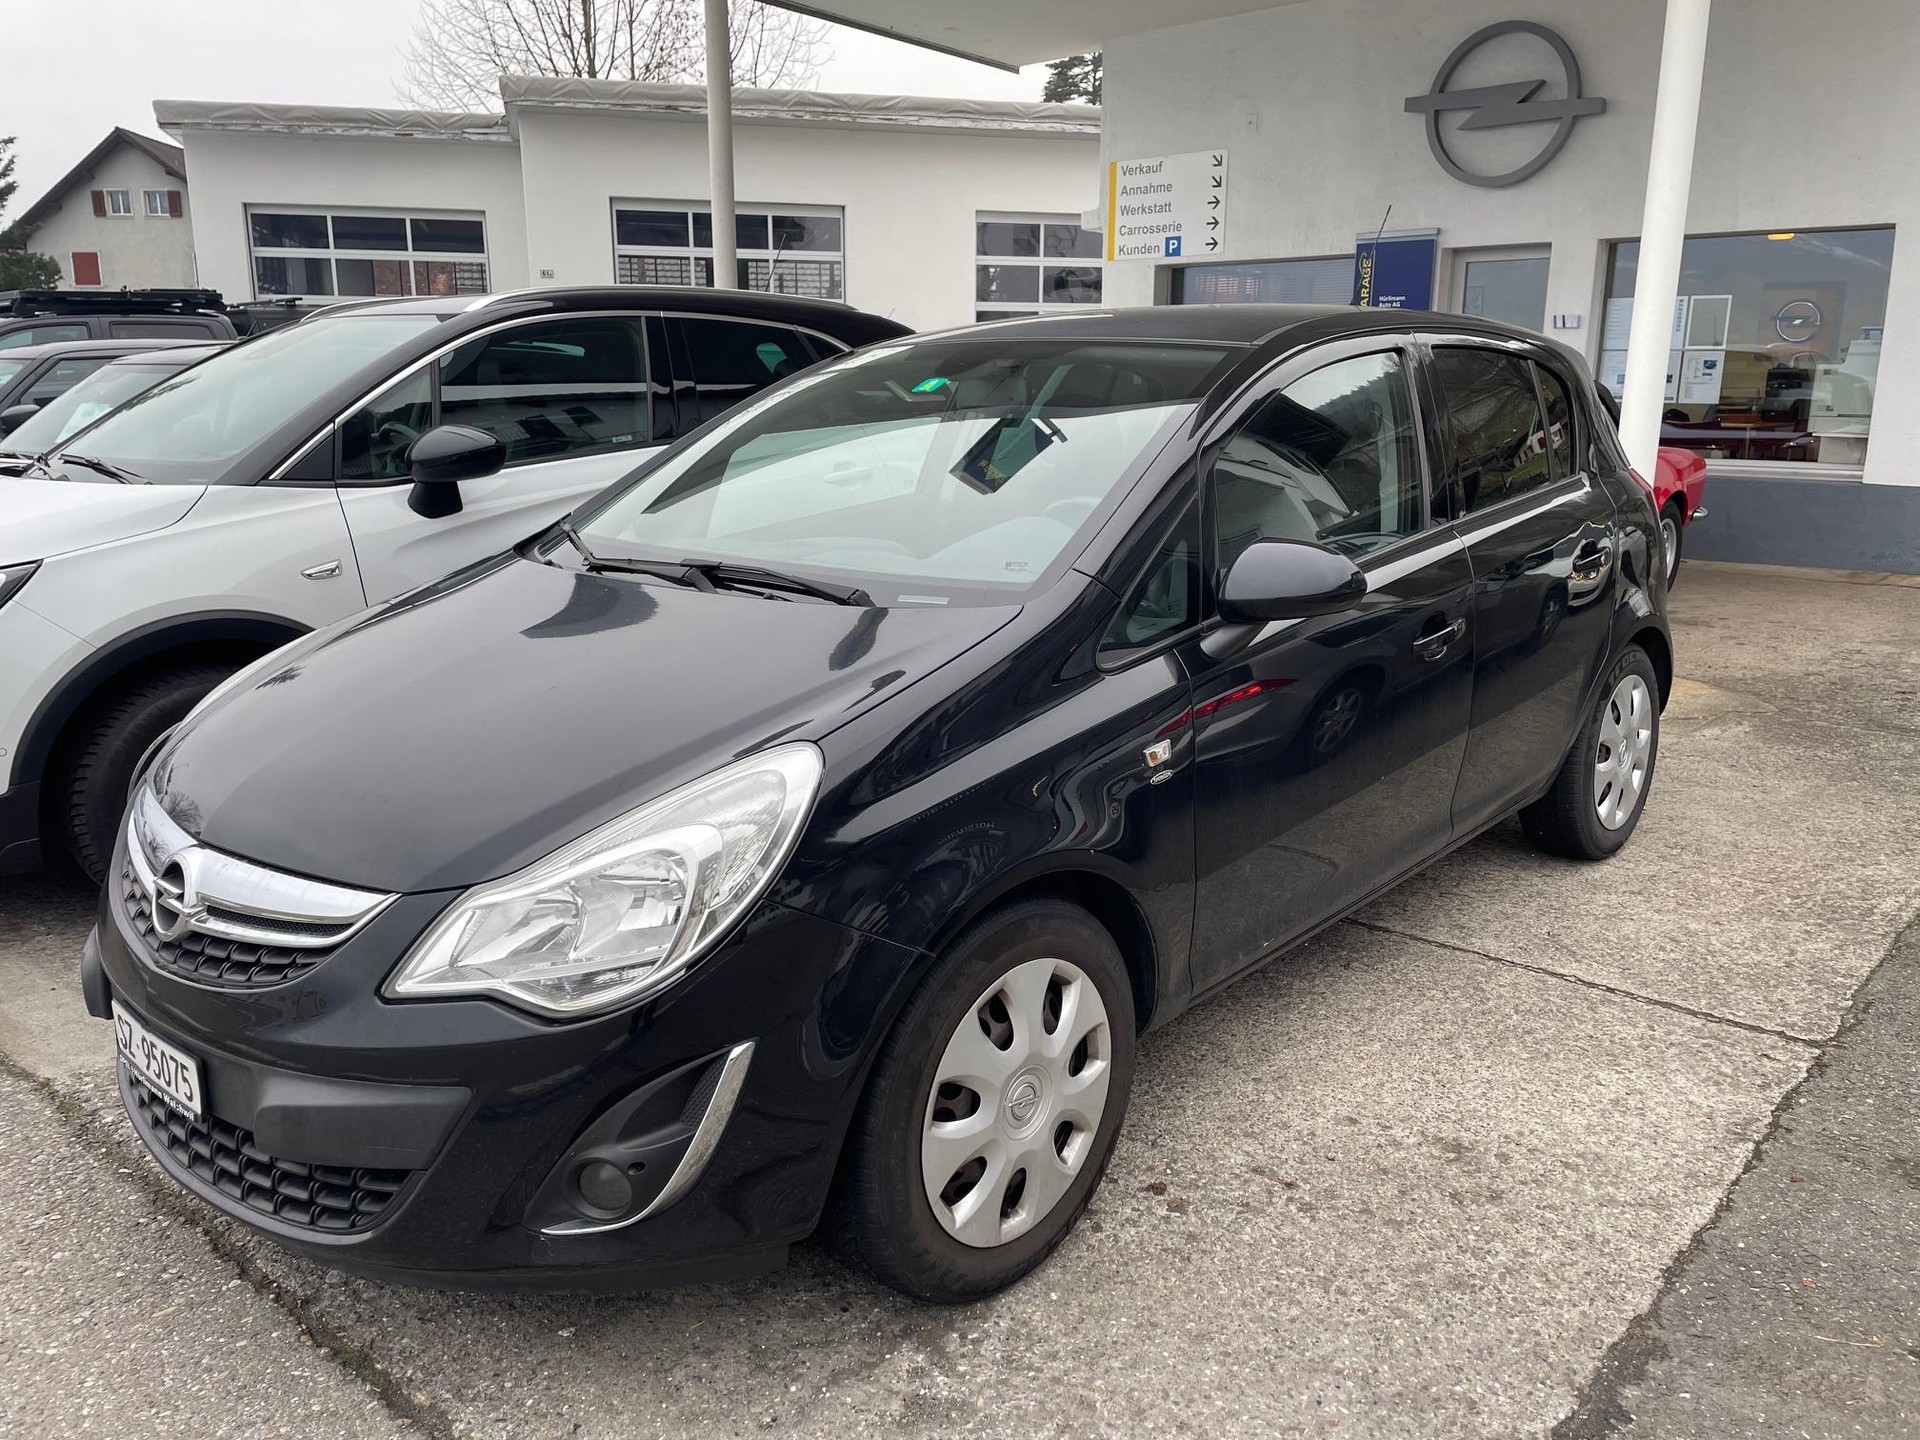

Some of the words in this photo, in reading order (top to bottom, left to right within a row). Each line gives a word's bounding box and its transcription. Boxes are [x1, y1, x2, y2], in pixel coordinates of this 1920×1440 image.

[1121, 161, 1163, 177] Verkauf
[1120, 183, 1172, 197] Annahme
[1120, 202, 1172, 217] Werkstatt
[1119, 221, 1183, 236] Carrosserie
[1118, 243, 1160, 256] Kunden
[1360, 258, 1372, 308] ARAGE
[117, 1014, 136, 1060] SZ
[141, 1034, 194, 1103] 95075
